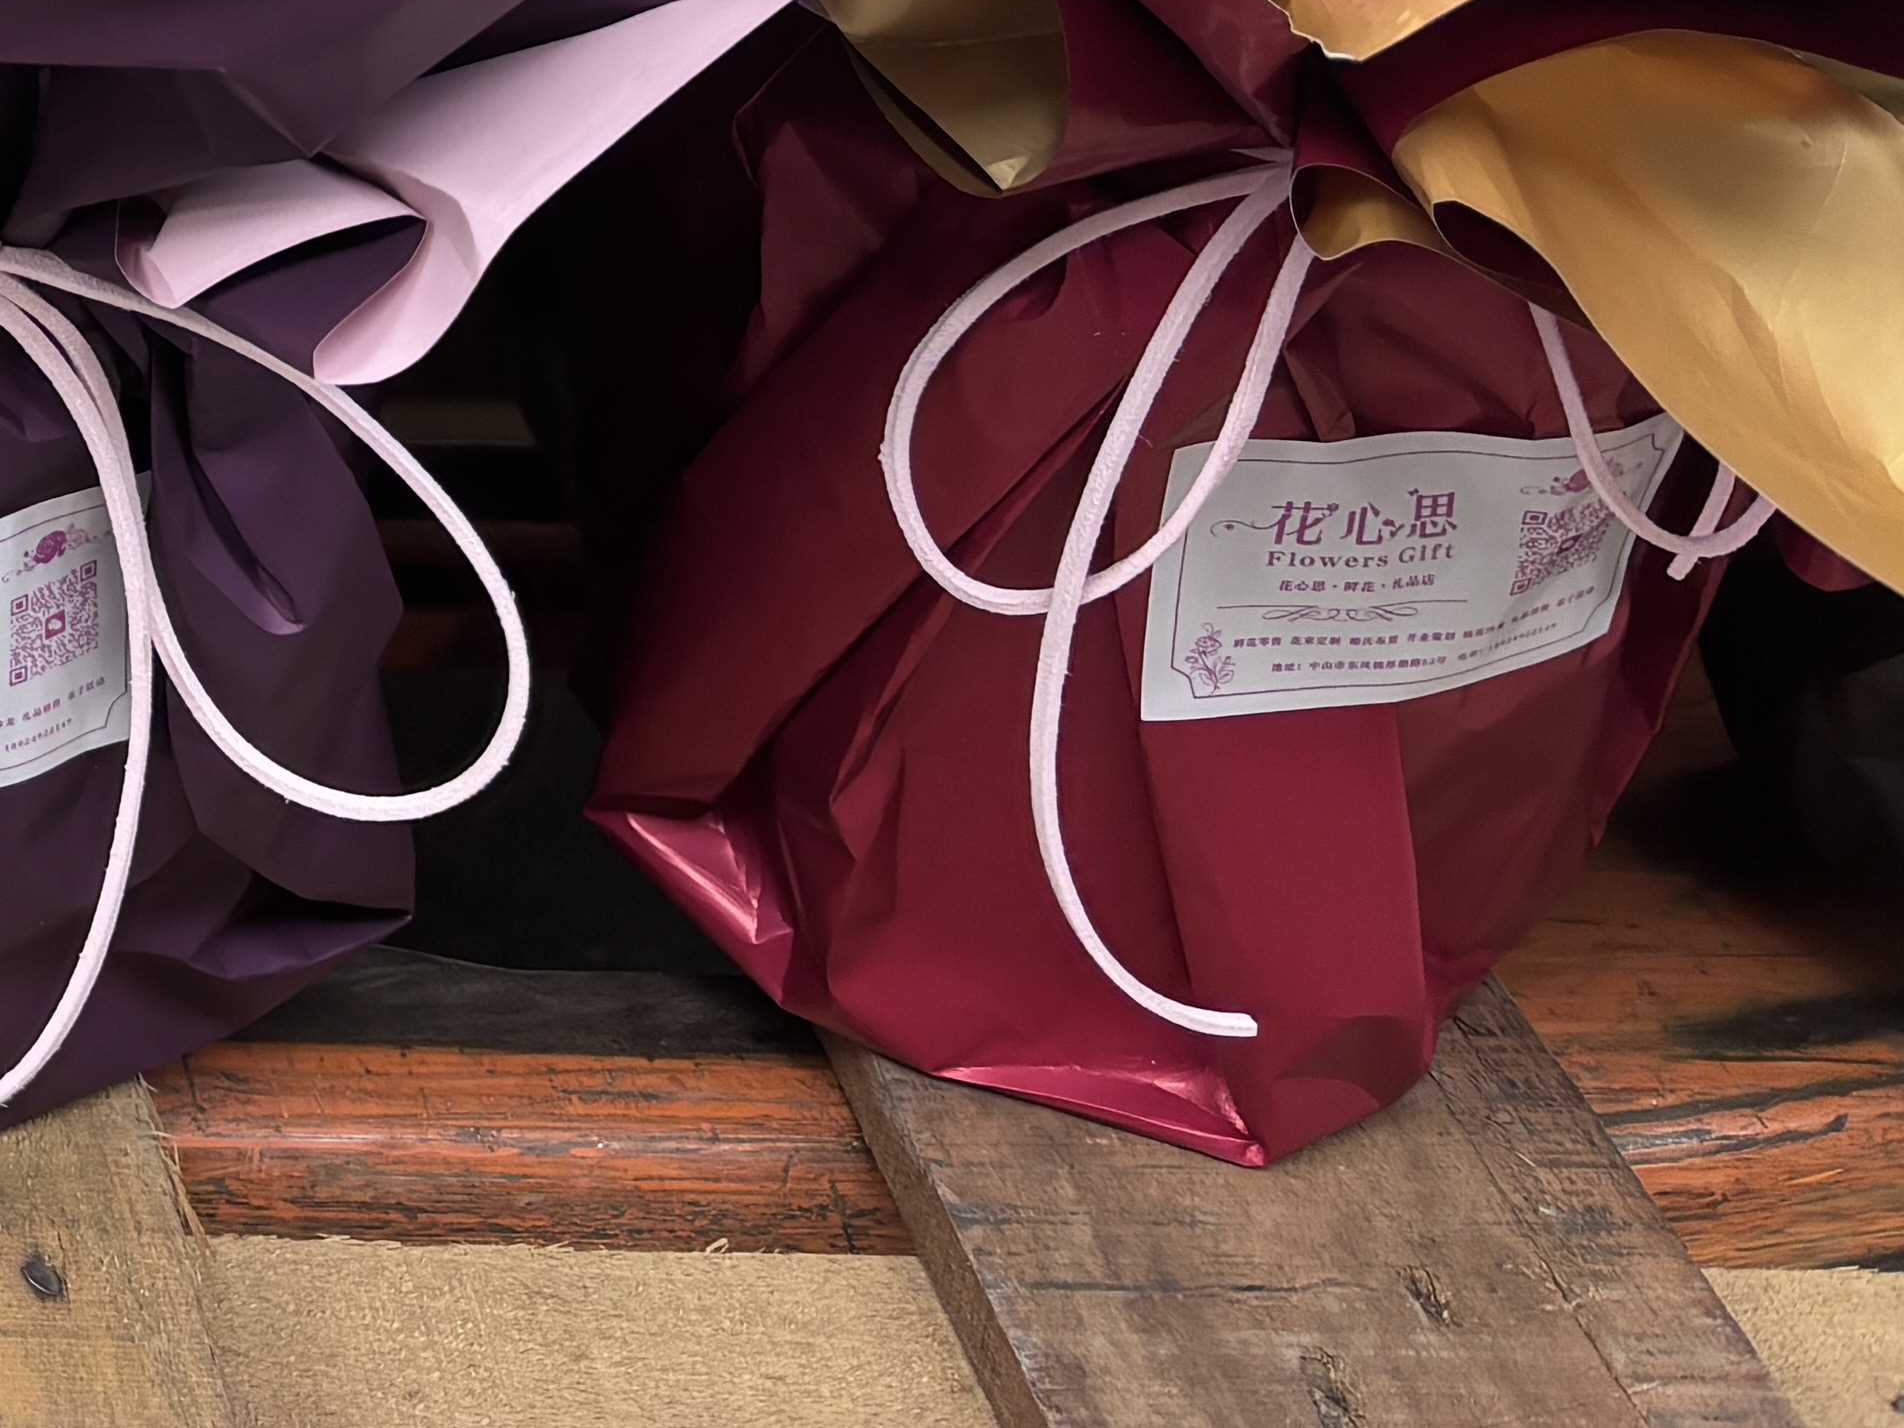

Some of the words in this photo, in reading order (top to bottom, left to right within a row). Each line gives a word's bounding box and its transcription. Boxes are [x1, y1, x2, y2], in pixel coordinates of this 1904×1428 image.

[1272, 488, 1458, 545] 花心思
[1266, 550, 1389, 568] Flowers
[1399, 543, 1456, 564] Gift
